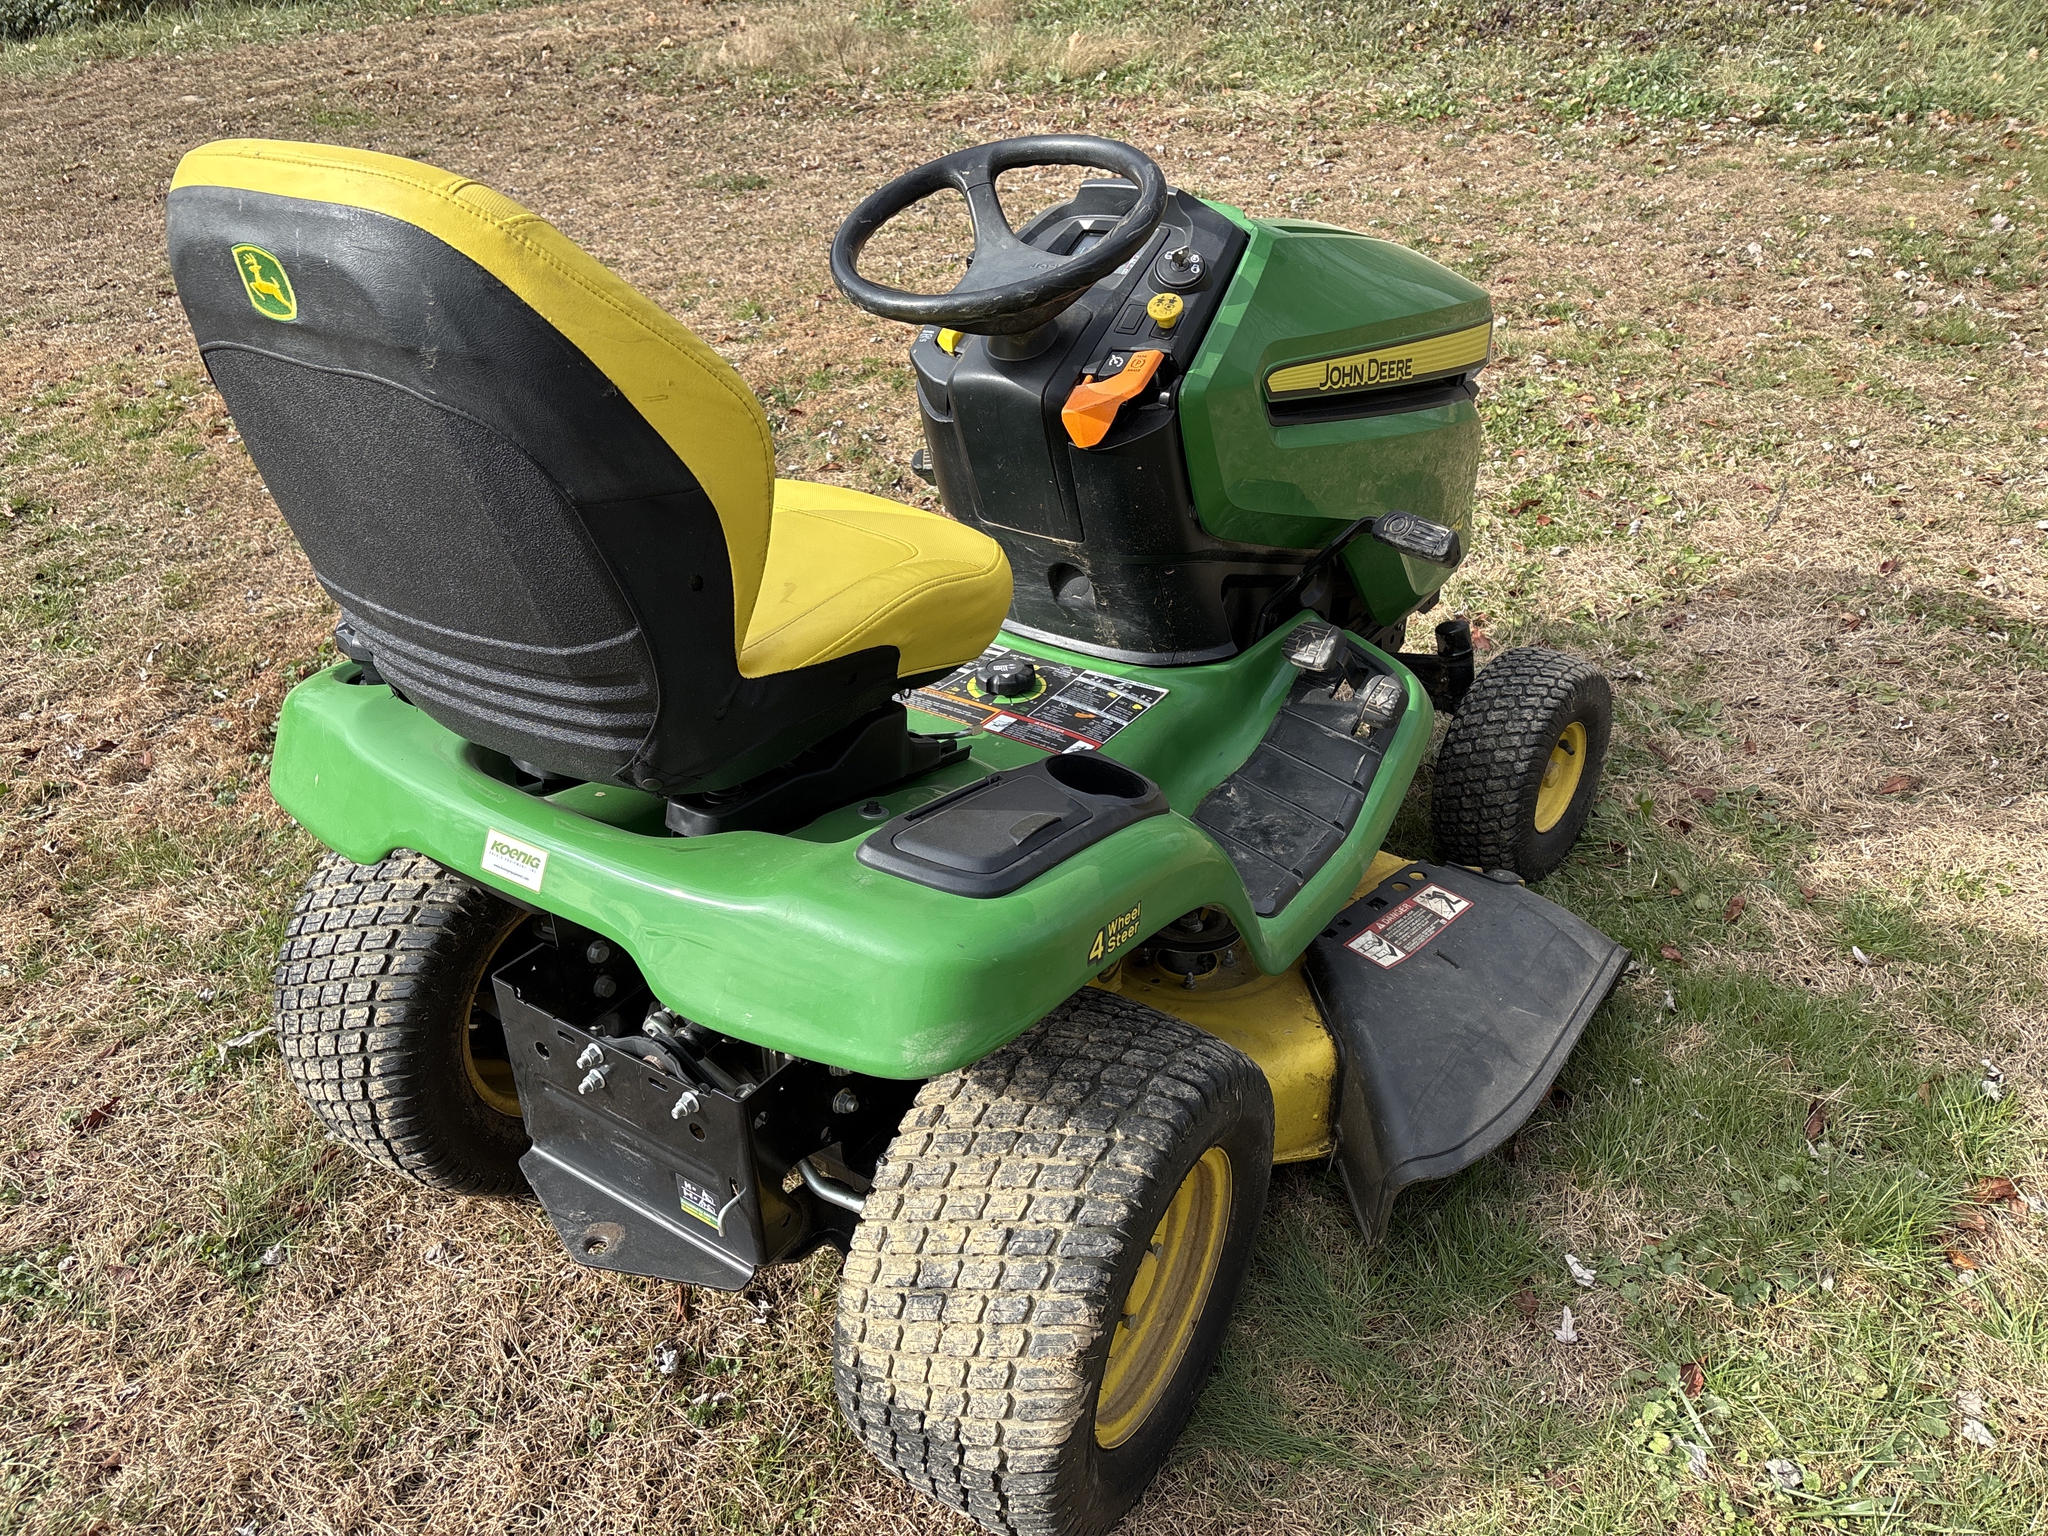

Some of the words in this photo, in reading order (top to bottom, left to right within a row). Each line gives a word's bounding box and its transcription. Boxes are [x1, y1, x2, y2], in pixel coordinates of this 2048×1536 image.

[1320, 363, 1364, 389] JOHN
[1368, 358, 1413, 383] DEERE
[1107, 902, 1141, 937] Wheel
[1382, 903, 1412, 924] DANGER
[1088, 929, 1105, 962] 4
[1107, 920, 1140, 953] Steer
